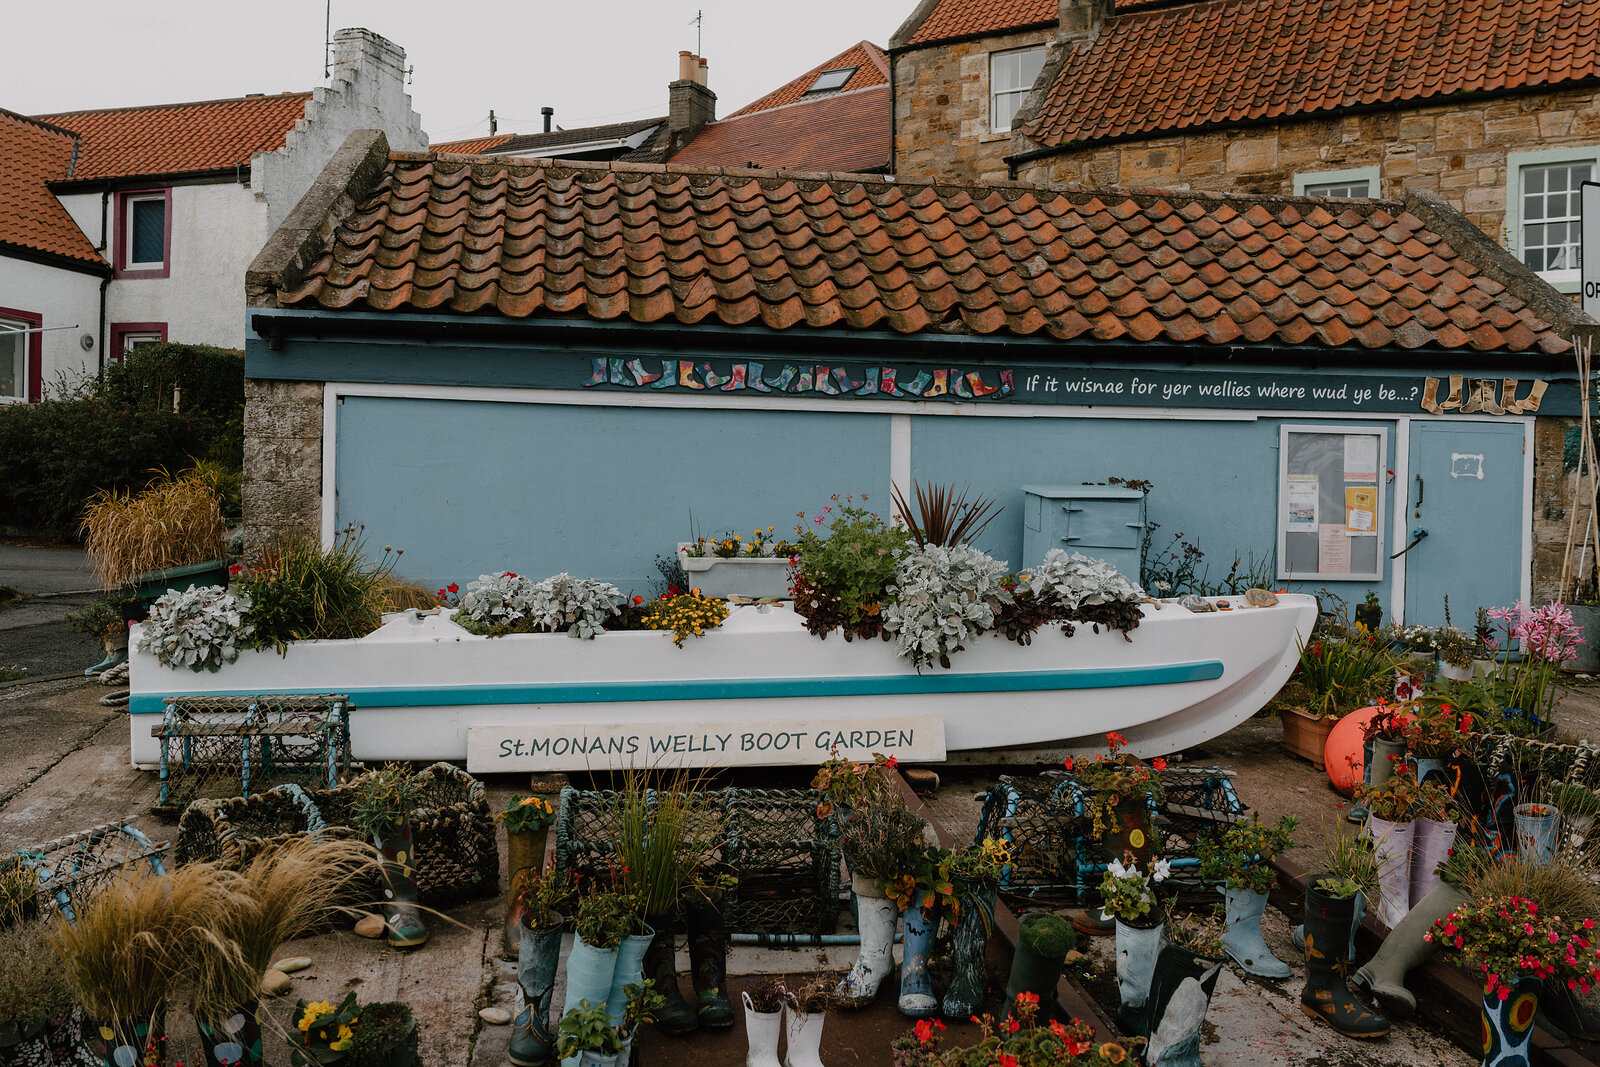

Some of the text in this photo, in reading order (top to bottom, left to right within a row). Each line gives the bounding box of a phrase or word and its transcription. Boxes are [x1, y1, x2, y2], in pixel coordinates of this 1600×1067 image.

[1026, 374, 1419, 405] If it wisnae for yer wellies where wud ye be...?
[498, 728, 914, 758] St.MONANS WELLY BOOT GARDEN
